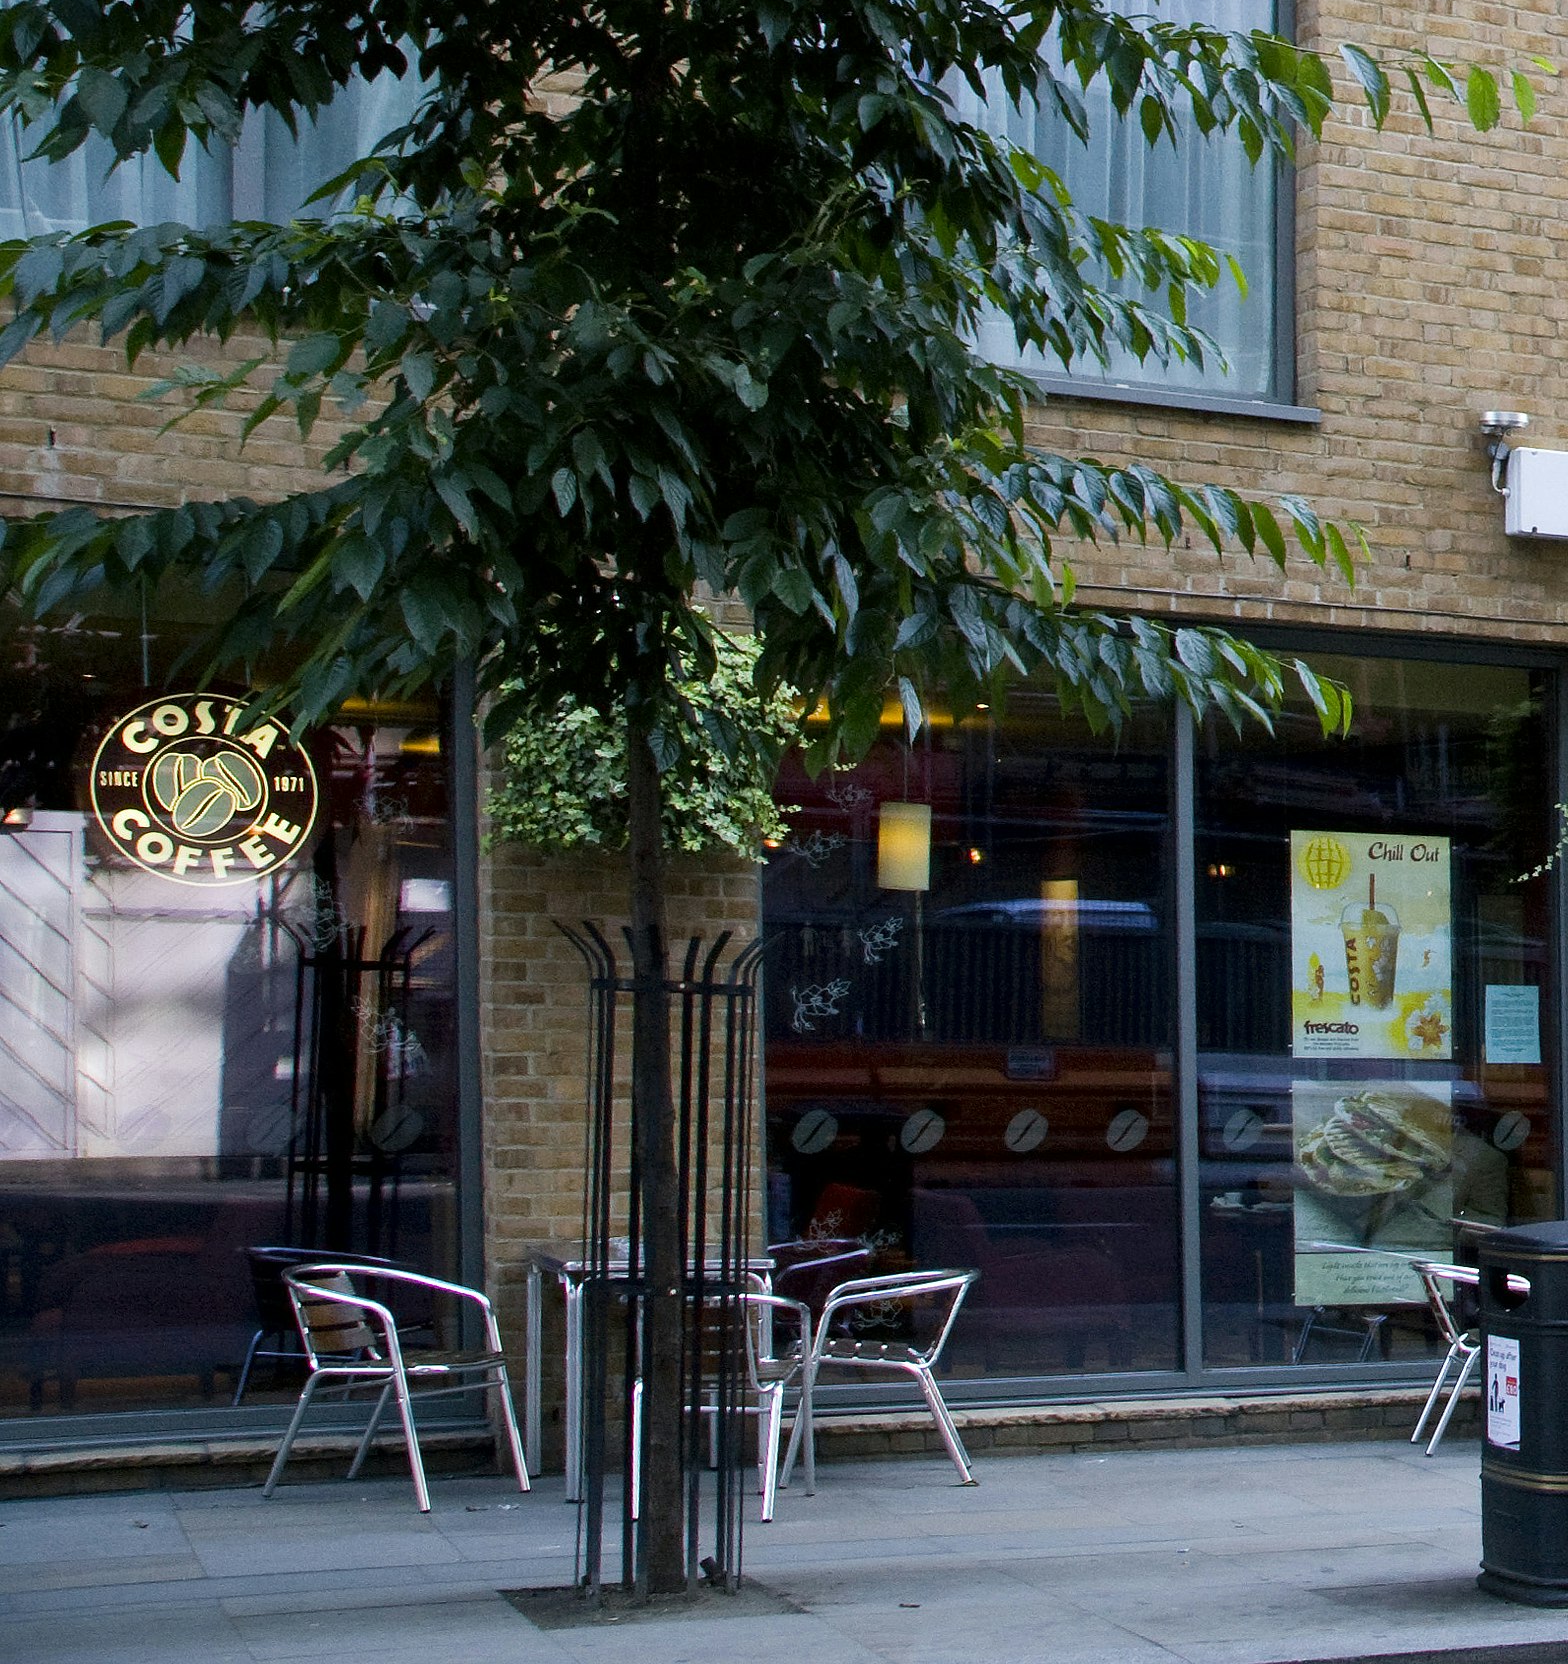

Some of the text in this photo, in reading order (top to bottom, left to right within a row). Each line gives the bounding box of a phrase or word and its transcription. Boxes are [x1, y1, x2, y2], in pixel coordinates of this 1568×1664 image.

[122, 700, 279, 760] COSTA
[99, 770, 138, 787] SINCE
[273, 776, 304, 792] 1971
[112, 808, 302, 879] COFFEE
[1368, 841, 1440, 863] Chill Out
[1345, 938, 1361, 1007] COSTA
[1303, 1020, 1360, 1035] frescato
